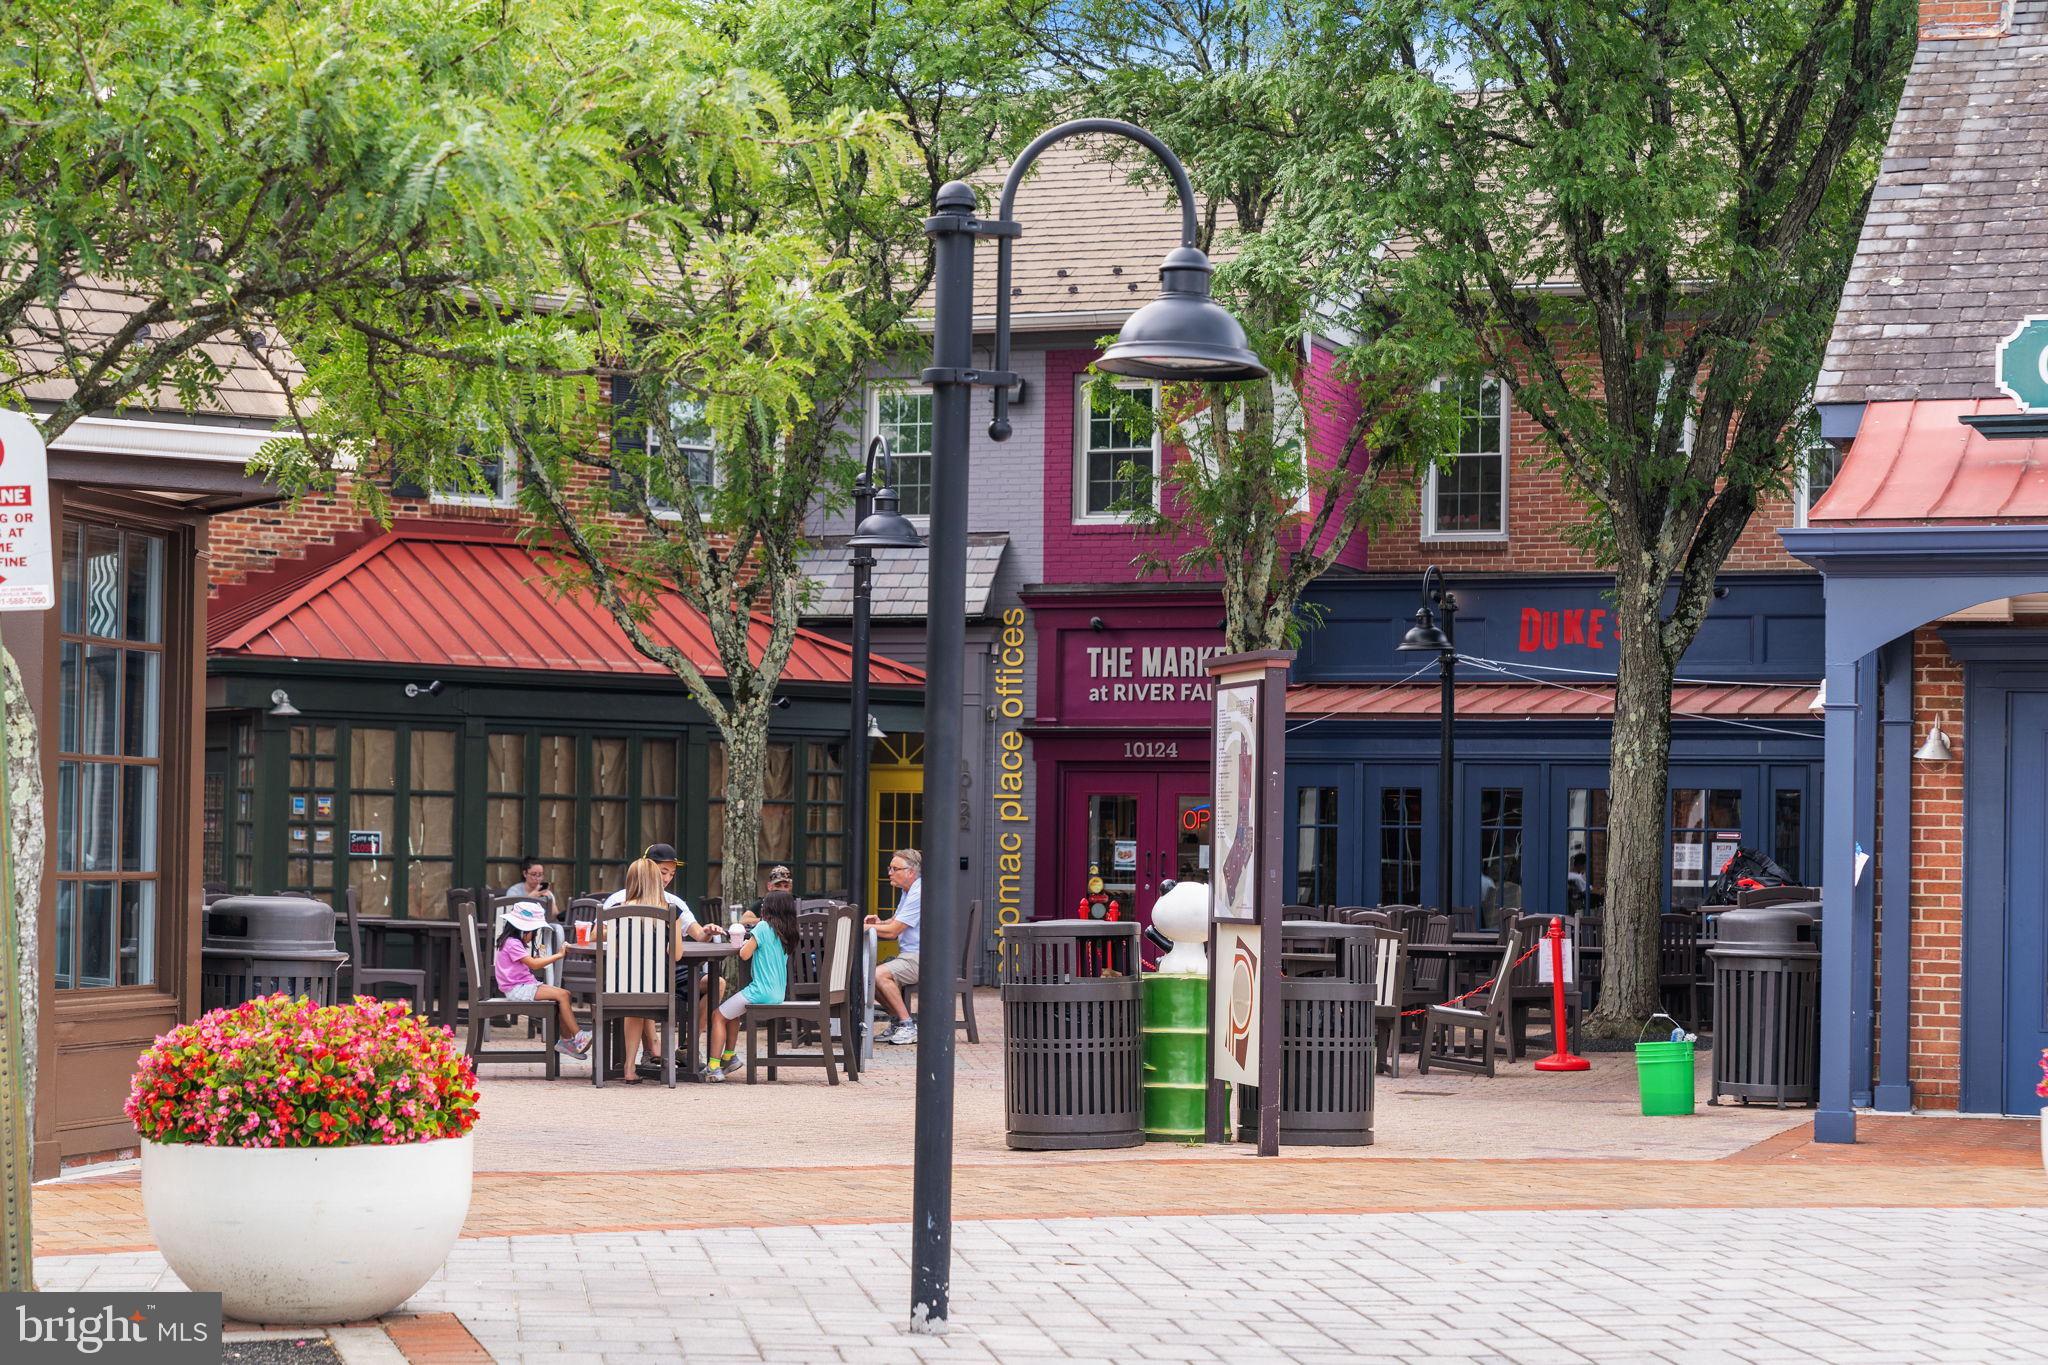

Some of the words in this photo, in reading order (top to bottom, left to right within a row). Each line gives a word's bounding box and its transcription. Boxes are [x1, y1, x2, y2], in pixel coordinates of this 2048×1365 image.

[0, 488, 26, 504] NE
[15, 513, 33, 523] OR
[9, 528, 24, 538] AT
[995, 607, 1025, 718] offices
[1087, 647, 1133, 678] THE
[1089, 684, 1108, 702] at
[1114, 684, 1175, 701] RIVER
[1124, 742, 1178, 758] 10124
[993, 731, 1030, 821] place
[993, 832, 1022, 973] omac
